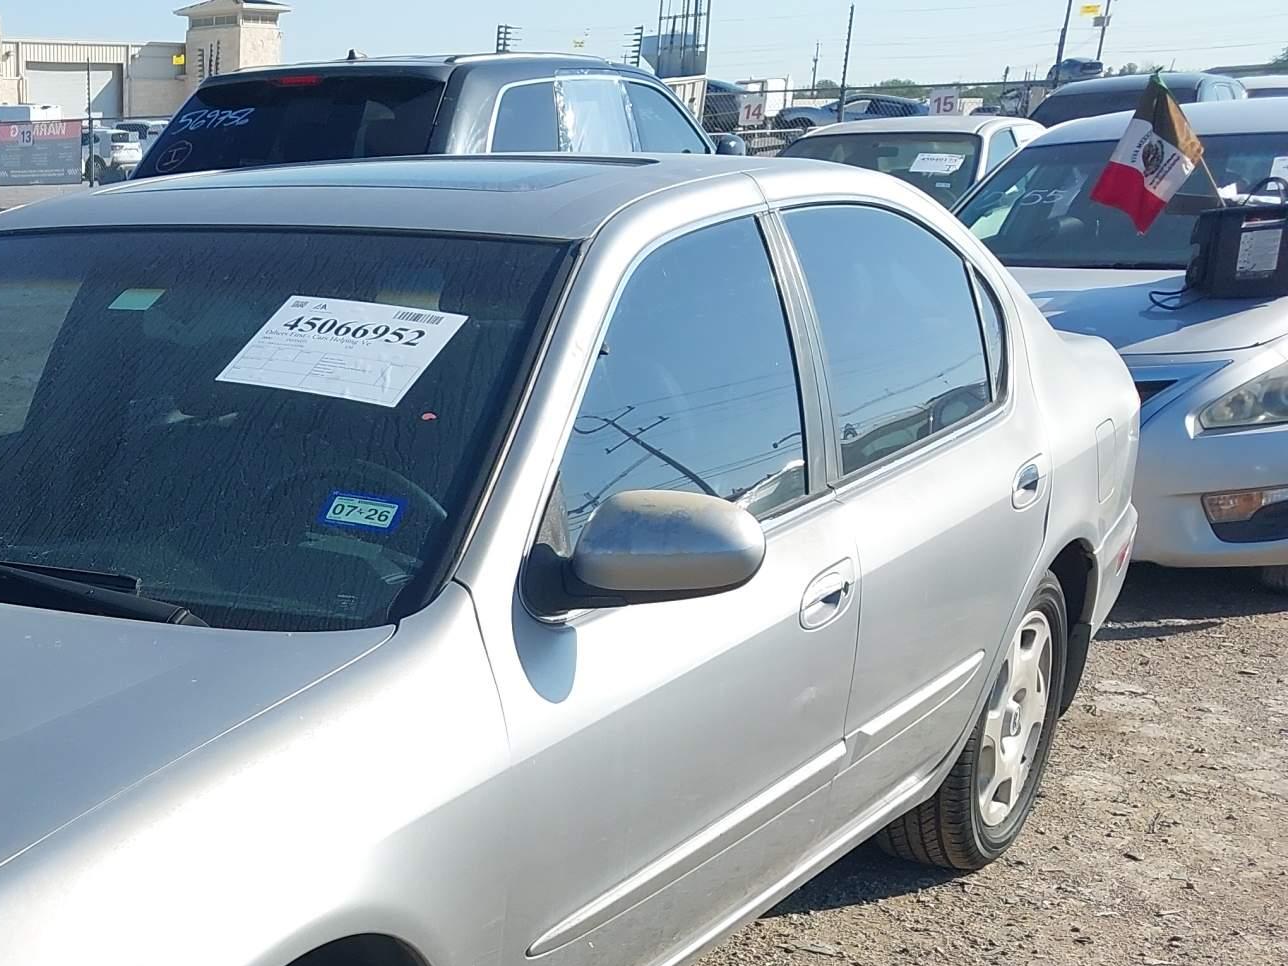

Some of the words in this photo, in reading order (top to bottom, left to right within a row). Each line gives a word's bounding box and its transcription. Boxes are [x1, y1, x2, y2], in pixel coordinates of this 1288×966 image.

[744, 104, 762, 120] 14
[934, 96, 954, 113] 15
[21, 130, 32, 143] 13
[283, 316, 426, 346] 45066952
[312, 333, 328, 342] Cars
[329, 336, 359, 347] Helping
